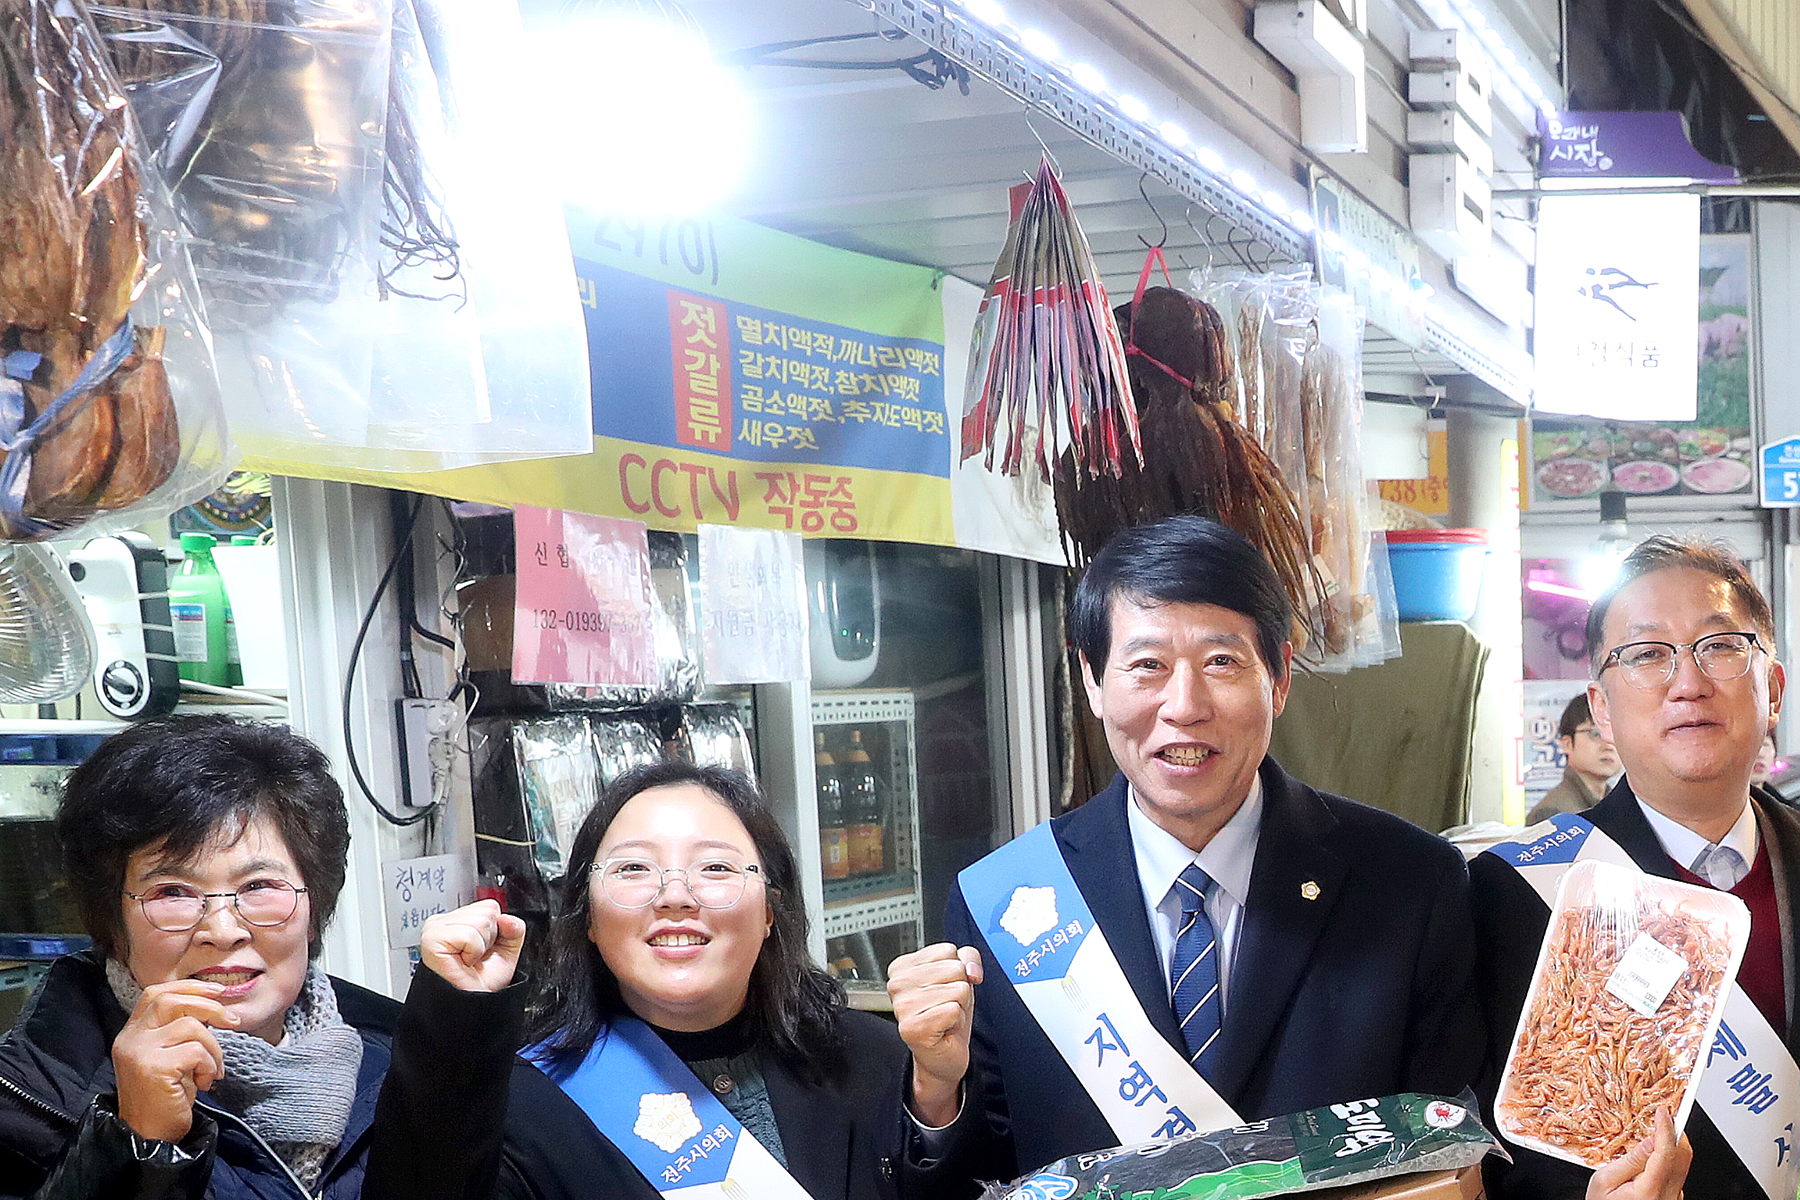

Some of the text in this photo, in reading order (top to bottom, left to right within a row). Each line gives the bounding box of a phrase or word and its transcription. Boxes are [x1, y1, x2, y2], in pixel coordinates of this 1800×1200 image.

[1548, 119, 1599, 140] 모래내
[1549, 139, 1605, 168] 시장
[679, 299, 722, 444] 젓갈류
[738, 419, 819, 451] 새우젓
[618, 452, 859, 533] CCTV 작동중
[1516, 824, 1587, 864] 전주시의회
[1014, 918, 1084, 978] 전주시의회
[660, 1123, 735, 1185] 전주시의회
[1329, 1097, 1396, 1159] 도미역
